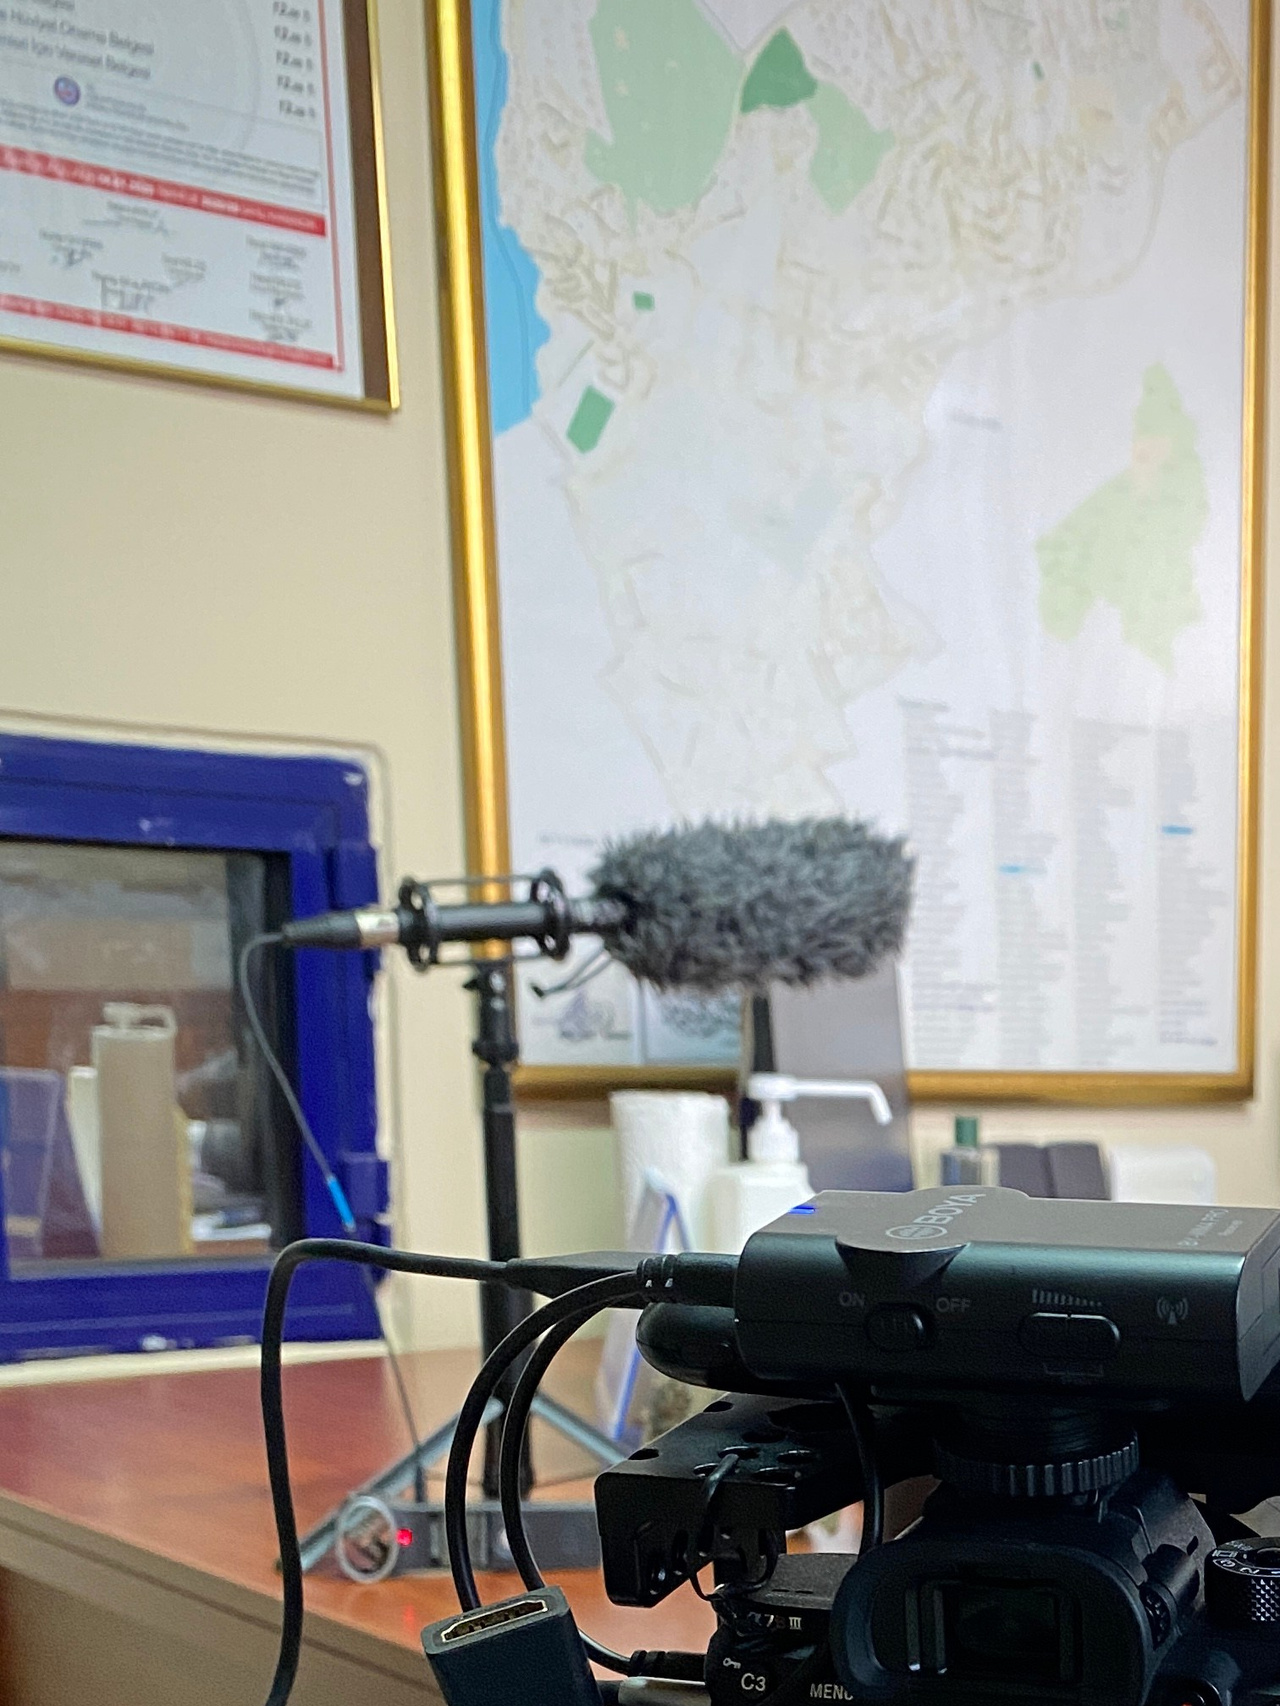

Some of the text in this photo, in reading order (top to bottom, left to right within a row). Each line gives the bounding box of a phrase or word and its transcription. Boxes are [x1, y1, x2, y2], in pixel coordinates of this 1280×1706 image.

[913, 1193, 986, 1224] BOYA
[838, 1291, 865, 1308] ON
[936, 1297, 971, 1313] OFF
[741, 1673, 766, 1692] C3
